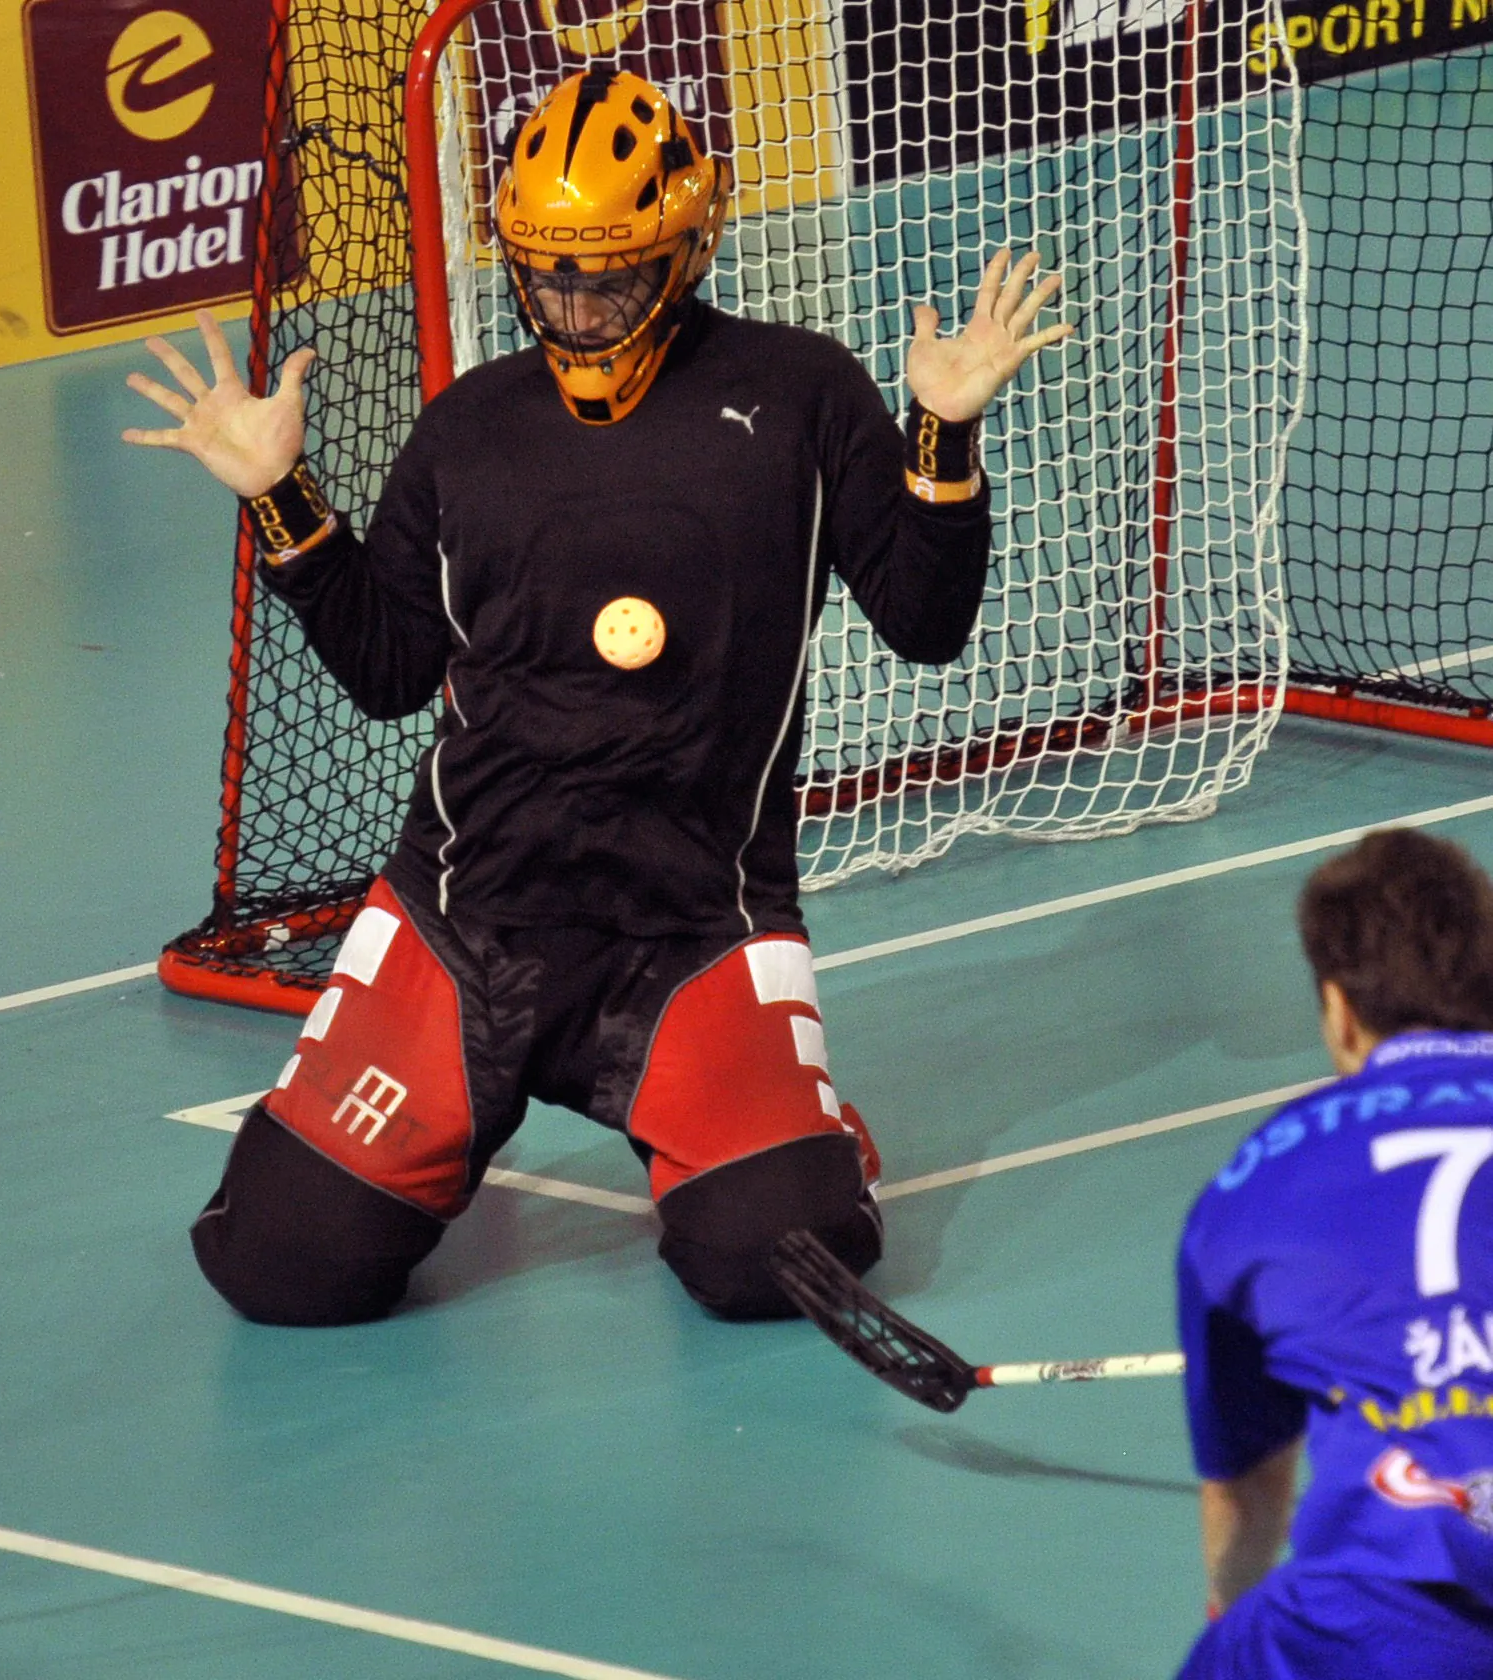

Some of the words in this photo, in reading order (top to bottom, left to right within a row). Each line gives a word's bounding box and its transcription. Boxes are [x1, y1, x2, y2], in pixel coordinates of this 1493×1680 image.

[1248, 0, 1425, 75] SPORT
[62, 155, 263, 234] Clarion
[510, 219, 633, 242] OXDOG
[97, 207, 245, 290] Hotel
[1370, 1126, 1493, 1297] 7
